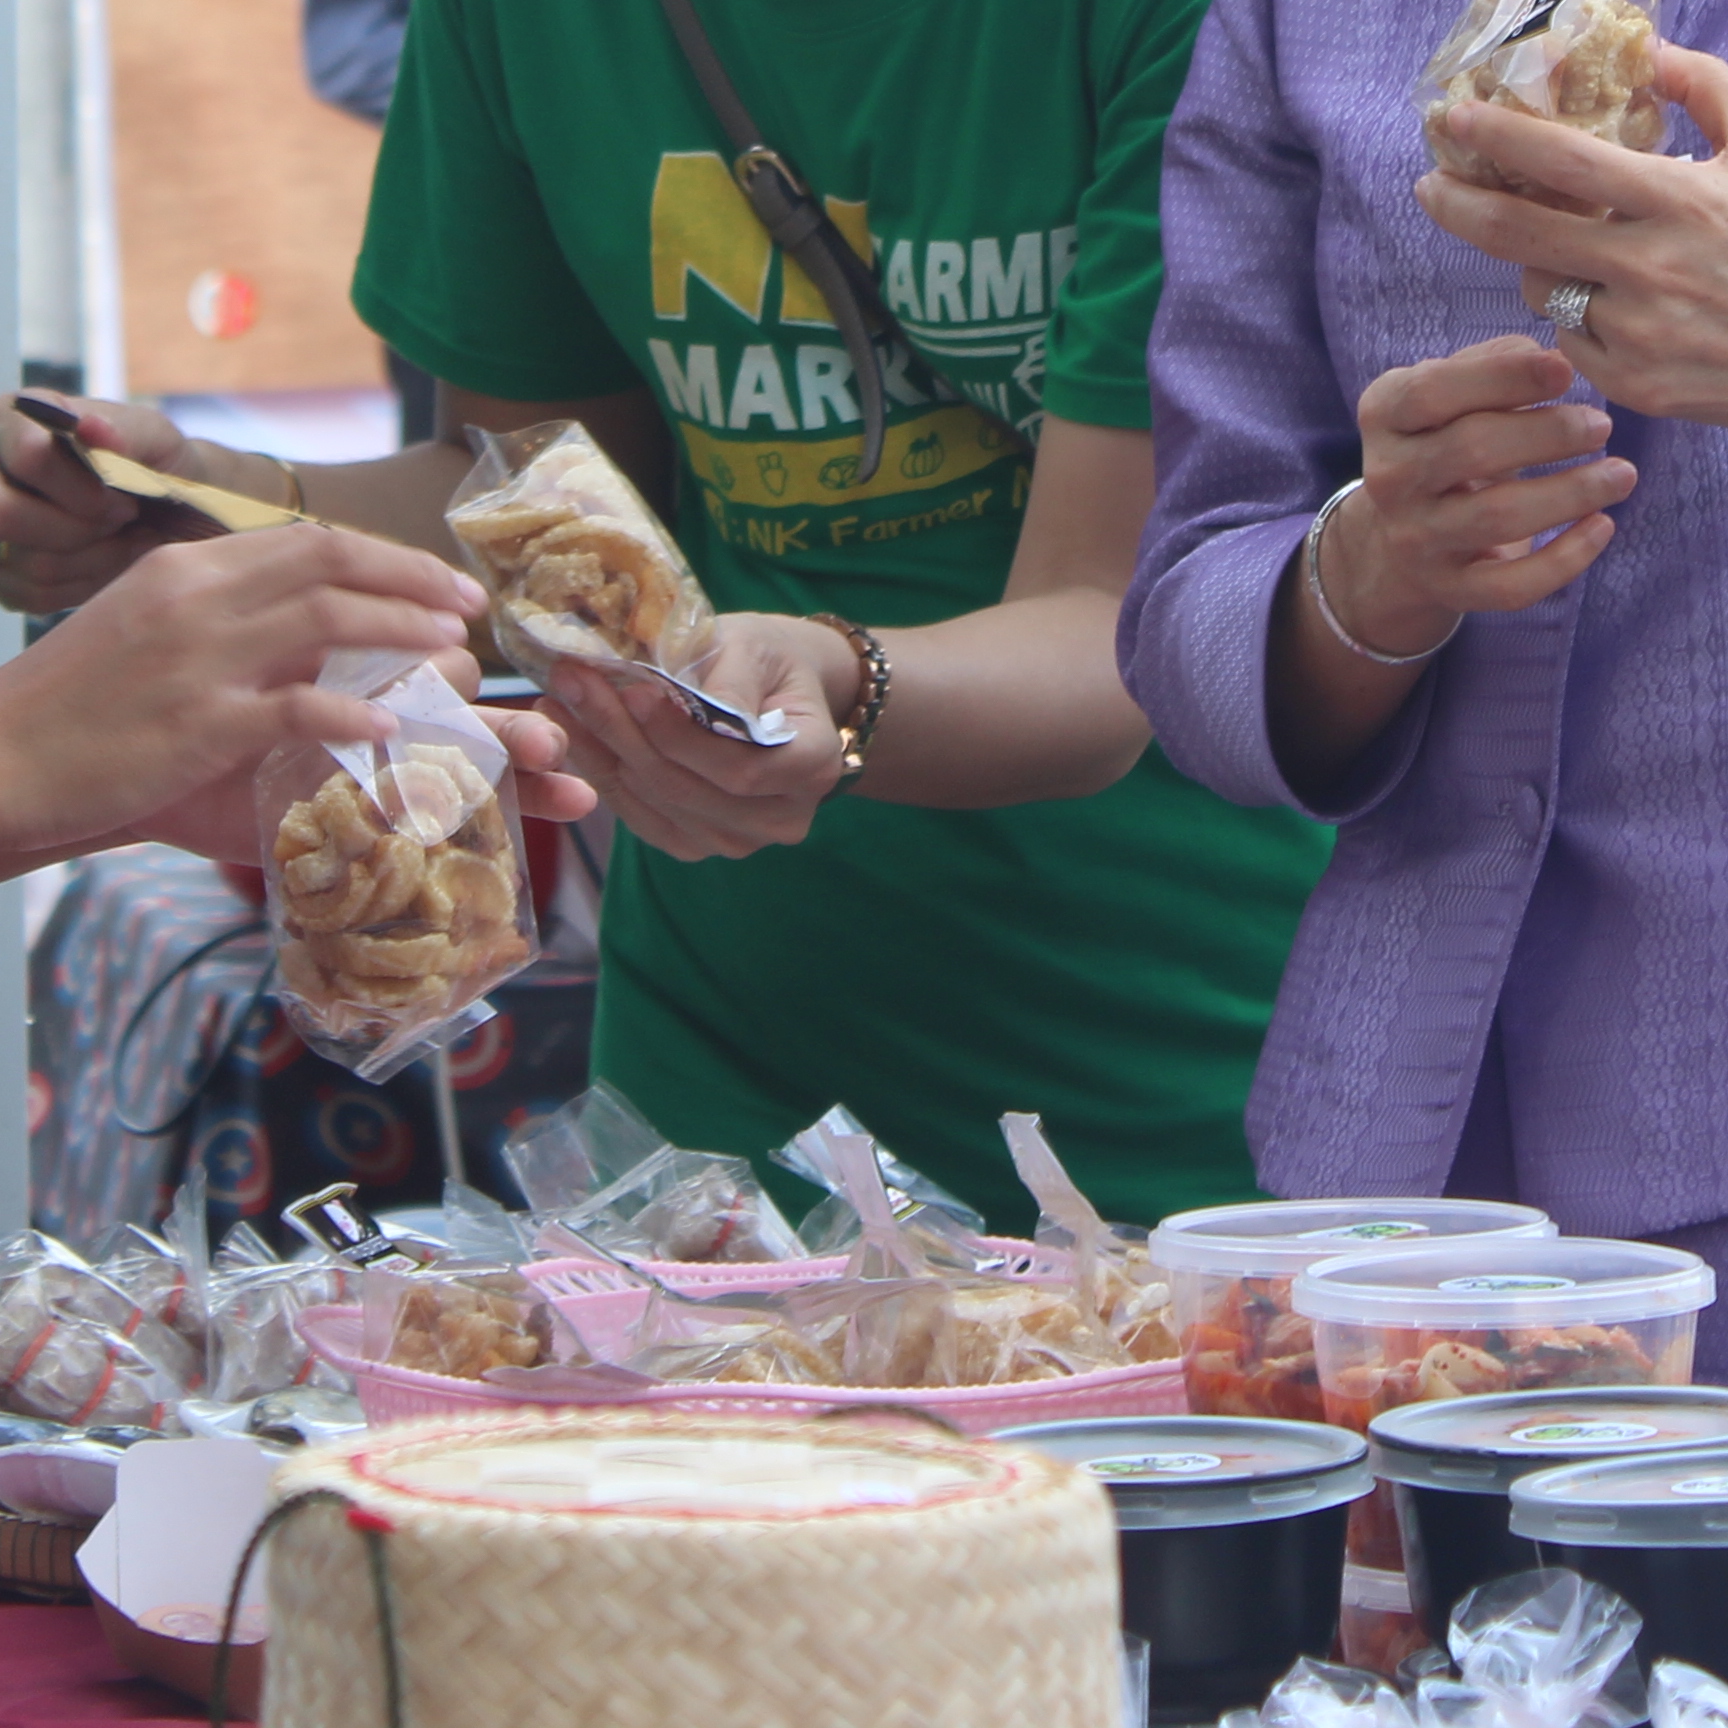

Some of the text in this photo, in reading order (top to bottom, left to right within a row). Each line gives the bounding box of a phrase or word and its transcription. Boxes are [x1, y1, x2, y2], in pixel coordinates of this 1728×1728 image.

[870, 224, 1078, 323] ARM
[647, 336, 972, 432] MARK
[746, 488, 994, 556] NK Farmer
